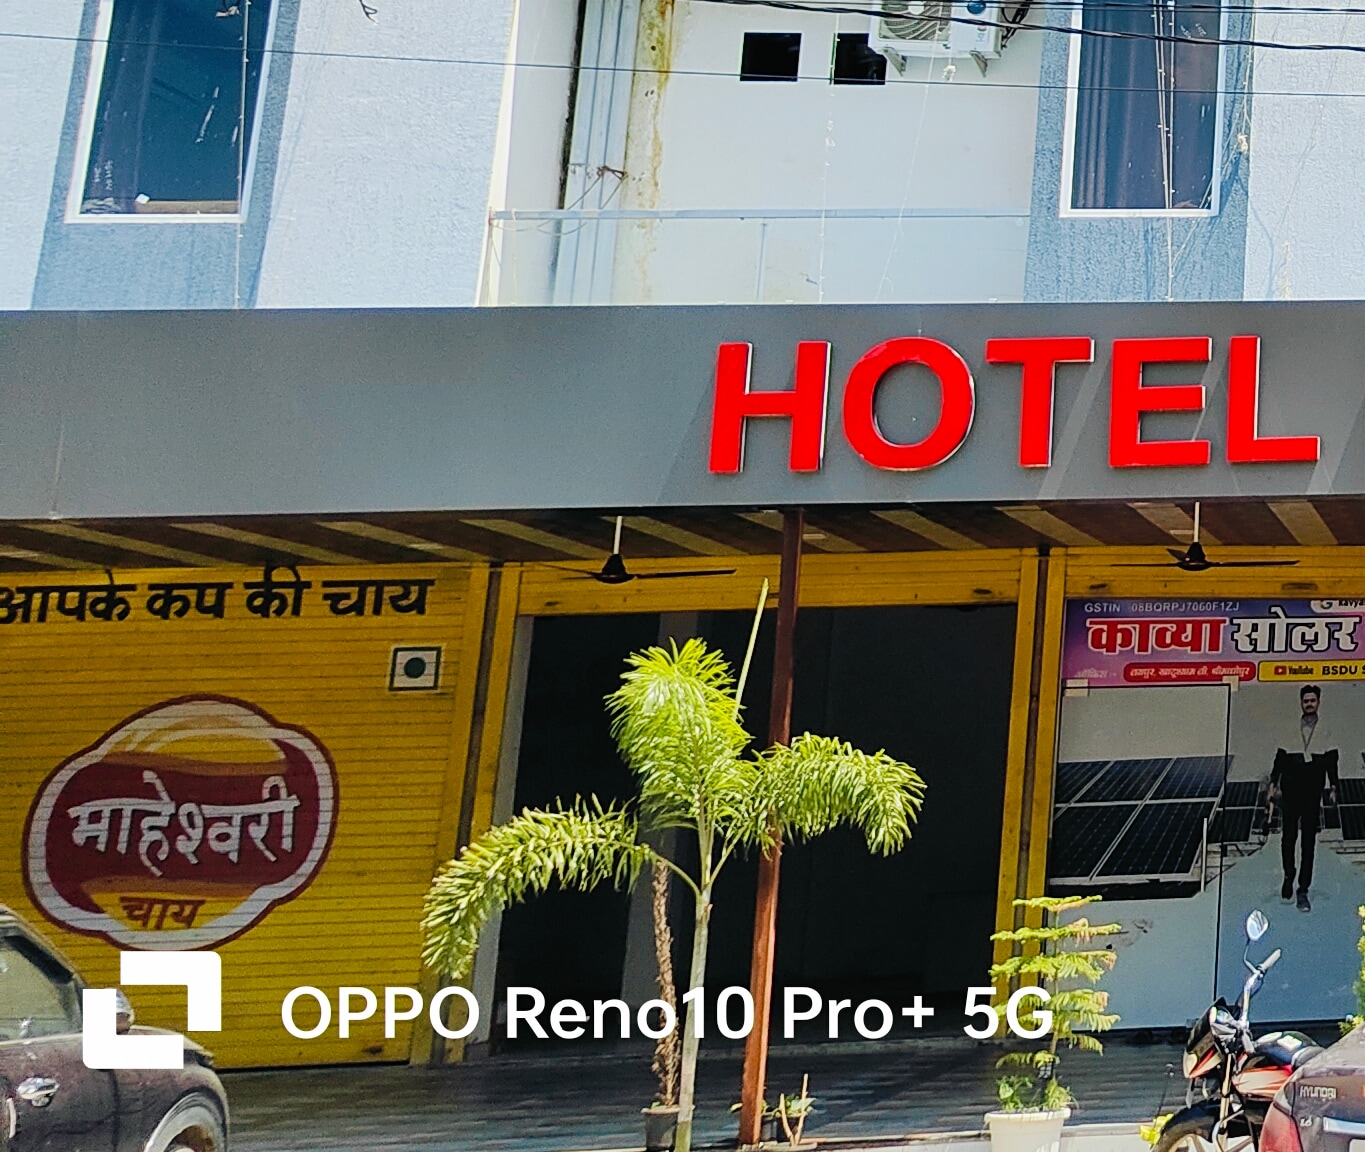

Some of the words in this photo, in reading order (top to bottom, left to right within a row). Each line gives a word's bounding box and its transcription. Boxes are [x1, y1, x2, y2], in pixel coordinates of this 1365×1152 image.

[706, 334, 1321, 474] HOTEL
[0, 569, 136, 624] आपके
[145, 582, 234, 621] कप
[244, 563, 312, 619] की
[322, 578, 436, 617] चाय
[1084, 602, 1121, 613] GSTIN
[1131, 601, 1239, 612] 08BQRPJ7060F1ZJ
[1086, 617, 1229, 654] काव्या
[1231, 605, 1362, 653] सोलर
[1322, 665, 1358, 676] BSDU
[67, 769, 300, 877] माहेश्वरी
[119, 895, 206, 931] चाय
[1300, 1086, 1336, 1098] HYUNDAI
